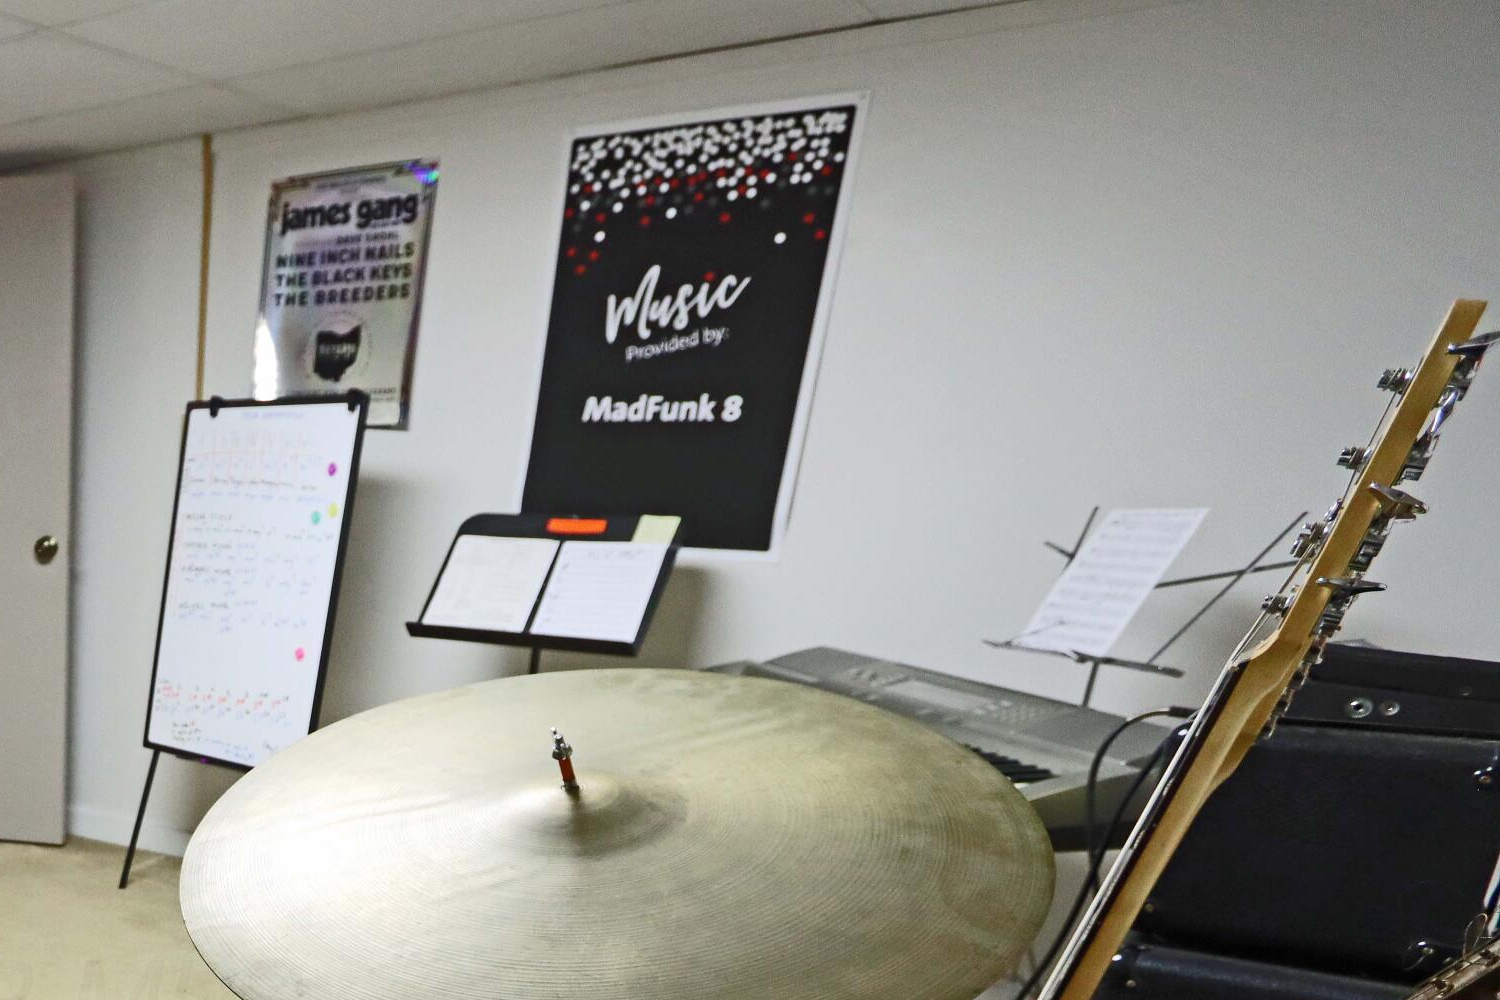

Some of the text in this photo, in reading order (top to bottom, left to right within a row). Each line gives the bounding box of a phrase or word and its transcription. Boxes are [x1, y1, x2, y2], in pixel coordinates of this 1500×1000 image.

[280, 193, 418, 237] james gang
[276, 241, 415, 268] NINE INCH NAILS
[276, 263, 413, 287] THE BLACK KEYS
[275, 283, 411, 306] THE BREEDERS
[605, 264, 752, 344] Music
[625, 332, 699, 362] Provided
[581, 393, 744, 422] MadFunk 8
